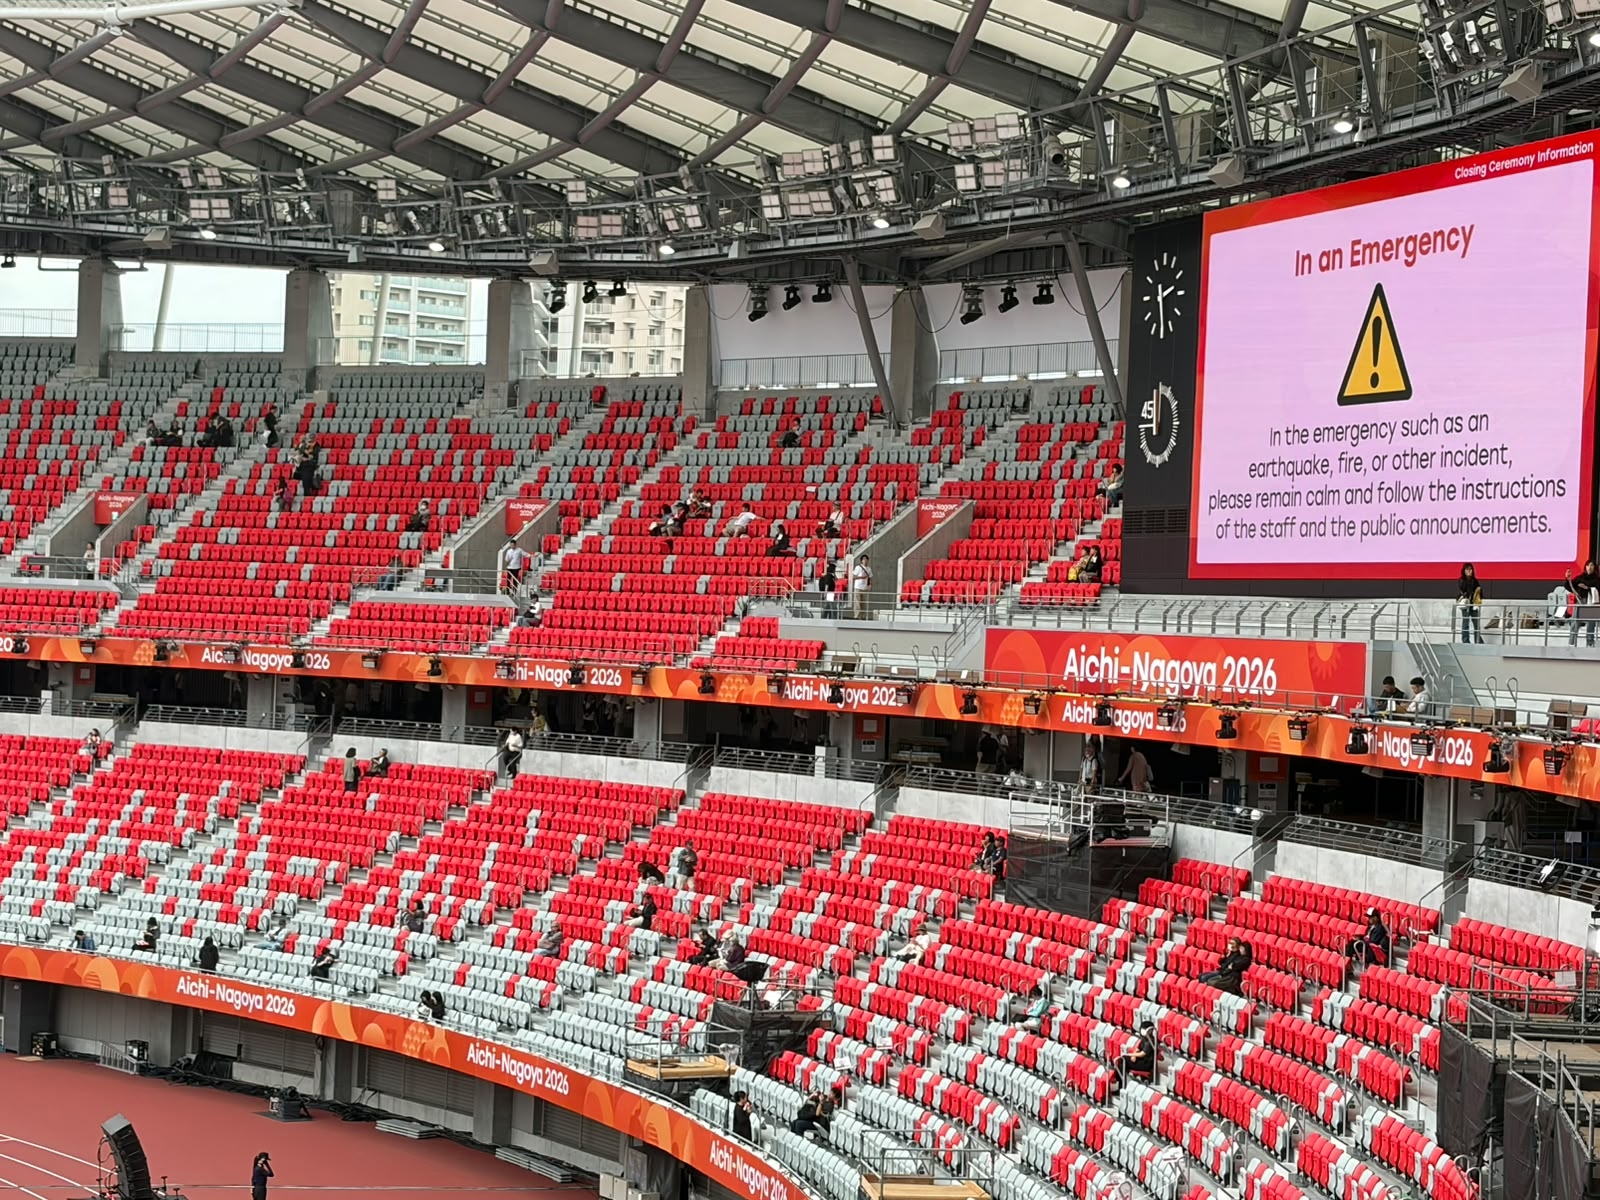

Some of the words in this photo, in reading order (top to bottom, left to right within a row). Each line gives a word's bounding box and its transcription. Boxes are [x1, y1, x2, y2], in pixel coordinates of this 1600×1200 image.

[1455, 163, 1486, 179] Closing
[1489, 153, 1535, 172] Ceremony
[1537, 141, 1594, 163] Information
[1295, 250, 1312, 277] In
[1318, 248, 1343, 272] an
[1350, 224, 1475, 267] Emergency
[1141, 401, 1154, 419] 45
[1270, 427, 1281, 447] In
[1285, 424, 1309, 445] the
[1313, 421, 1397, 447] emergency
[1401, 413, 1439, 437] such
[1443, 415, 1463, 433] as
[1468, 413, 1489, 432] an
[1249, 454, 1333, 482] earthquake,
[1338, 451, 1367, 477] fire,
[1372, 454, 1388, 471] or
[1392, 447, 1436, 471] other
[1440, 443, 1513, 469] incident,
[1208, 490, 1252, 516] please
[1255, 485, 1302, 508] remain
[1306, 484, 1340, 506] calm
[1345, 482, 1373, 504] and
[1378, 480, 1424, 503] follow
[1429, 478, 1456, 501] the
[1462, 473, 1566, 500] instructions
[1215, 519, 1231, 539] of
[1234, 518, 1256, 539] the
[1260, 516, 1296, 538] staff
[1300, 515, 1326, 538] and
[1331, 515, 1356, 537] the
[1360, 513, 1405, 543] public
[1410, 511, 1552, 535] announcements.
[201, 646, 294, 671] AicNagoya
[298, 653, 330, 669] 026
[493, 662, 587, 688] chi-Nagoa
[590, 667, 622, 686] 2026
[1063, 644, 1217, 699] Aichi-Nagoya
[1222, 655, 1277, 696] 2026
[782, 680, 868, 709] Aichi-Ngoya
[871, 686, 904, 707] 202
[1062, 699, 1154, 735] Aichiagoya
[1156, 709, 1187, 732] 26
[1438, 736, 1473, 766] 2026
[176, 975, 263, 1013] Aichi-Nagoya
[266, 994, 296, 1016] 2026
[467, 1042, 543, 1088] Aichi-Nagoya
[545, 1067, 569, 1095] 2026
[710, 1140, 769, 1200] Aichi-Nagoya
